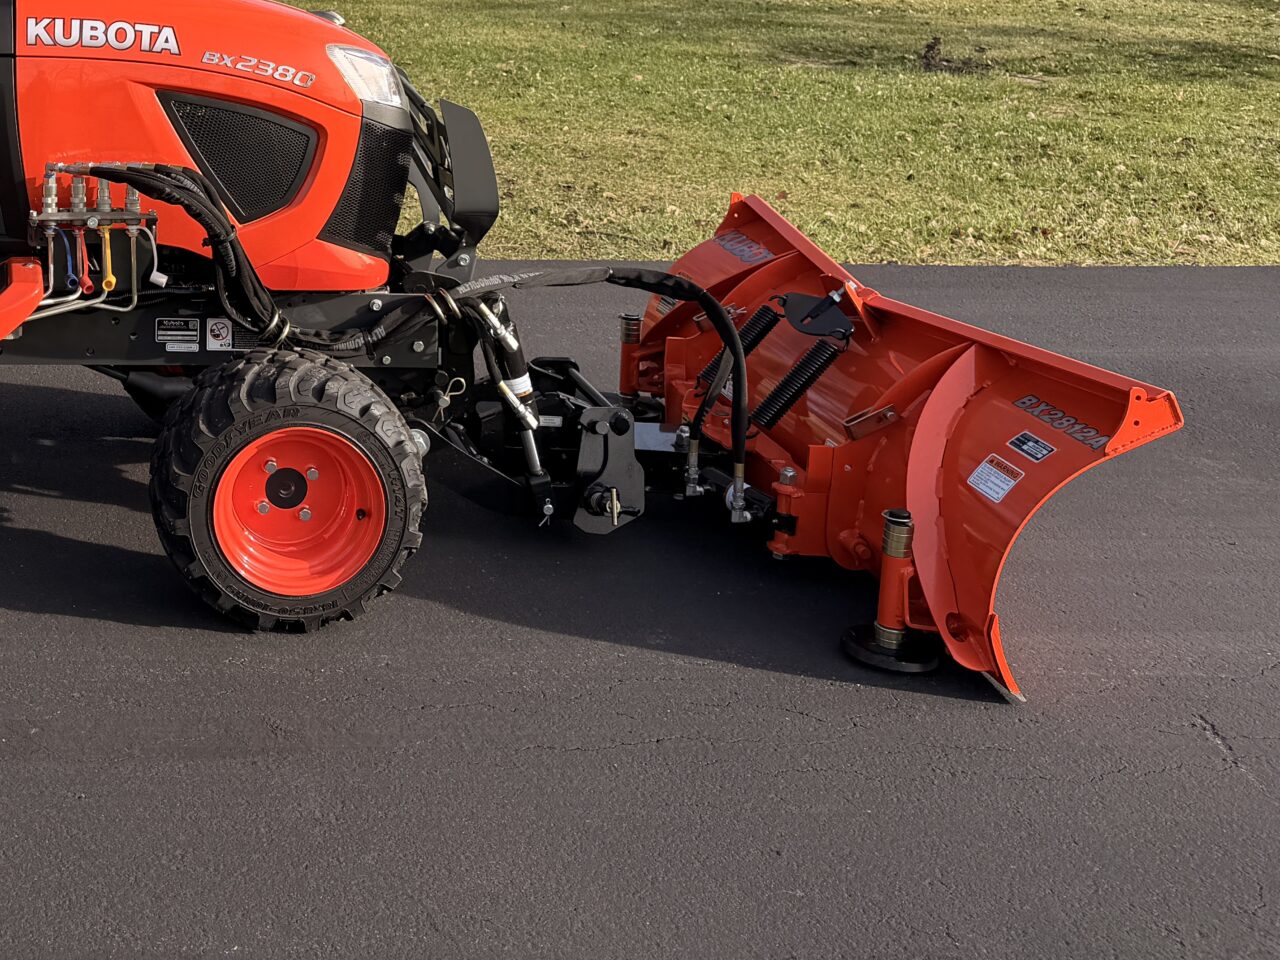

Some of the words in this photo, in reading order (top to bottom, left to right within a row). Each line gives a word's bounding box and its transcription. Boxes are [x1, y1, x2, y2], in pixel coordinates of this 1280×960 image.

[26, 17, 182, 56] KUBOTA
[201, 50, 316, 88] BX2380
[1012, 394, 1111, 451] BX2812A
[993, 461, 1020, 479] WARNING
